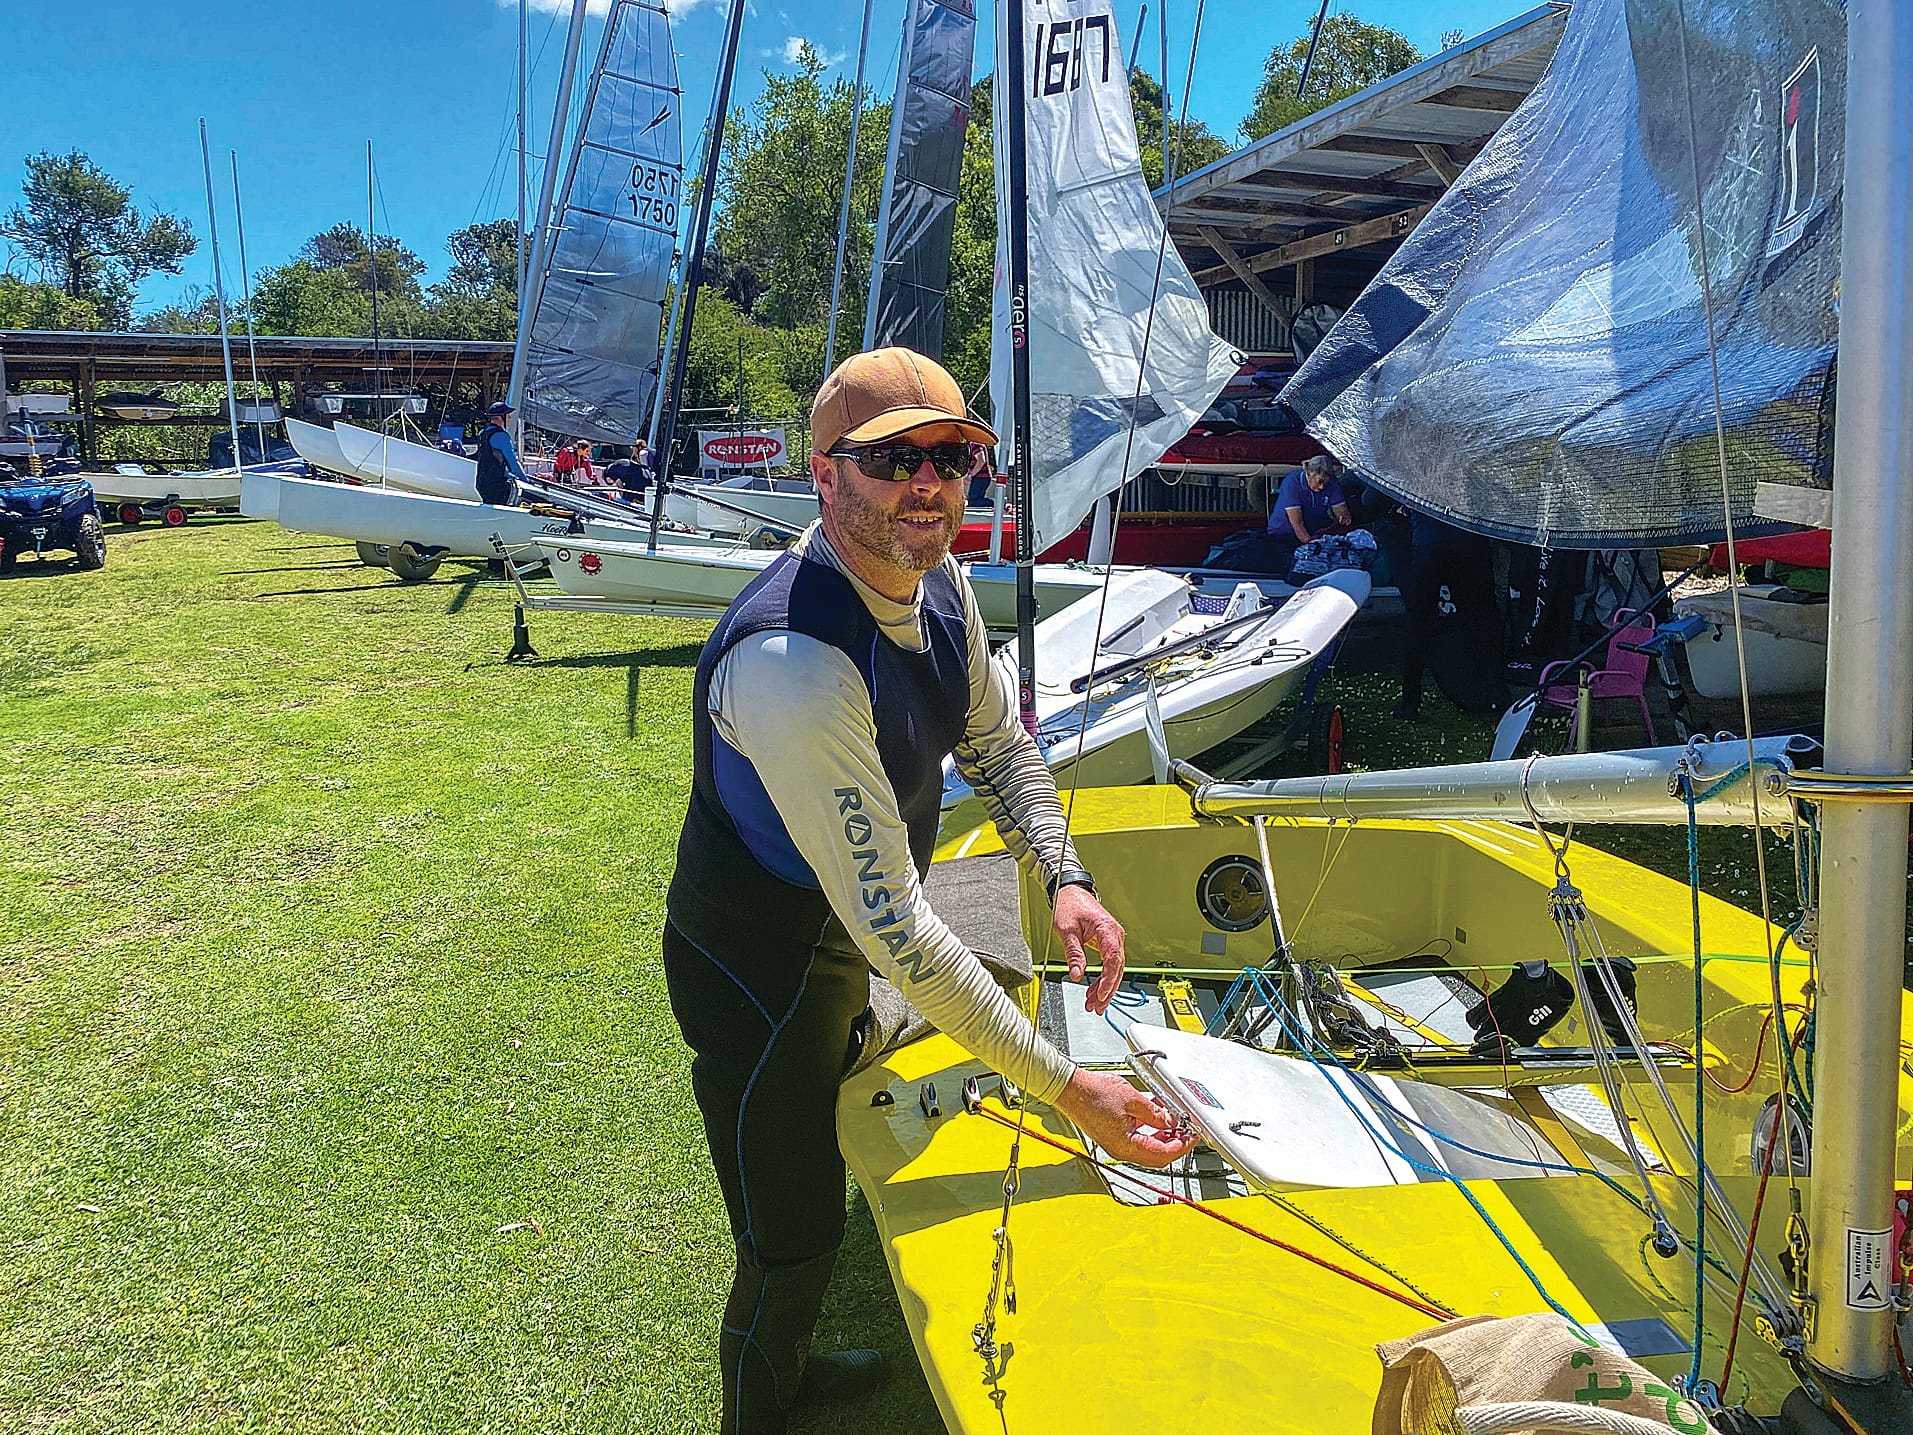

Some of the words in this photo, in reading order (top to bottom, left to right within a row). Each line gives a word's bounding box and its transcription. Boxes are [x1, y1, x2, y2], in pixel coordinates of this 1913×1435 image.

[1032, 14, 1110, 99] 1687
[627, 193, 676, 227] 1750
[833, 786, 937, 985] RONSTAN
[1528, 1004, 1553, 1026] Gill
[1853, 1235, 1862, 1280] Australian
[1864, 1242, 1872, 1275] Impulse
